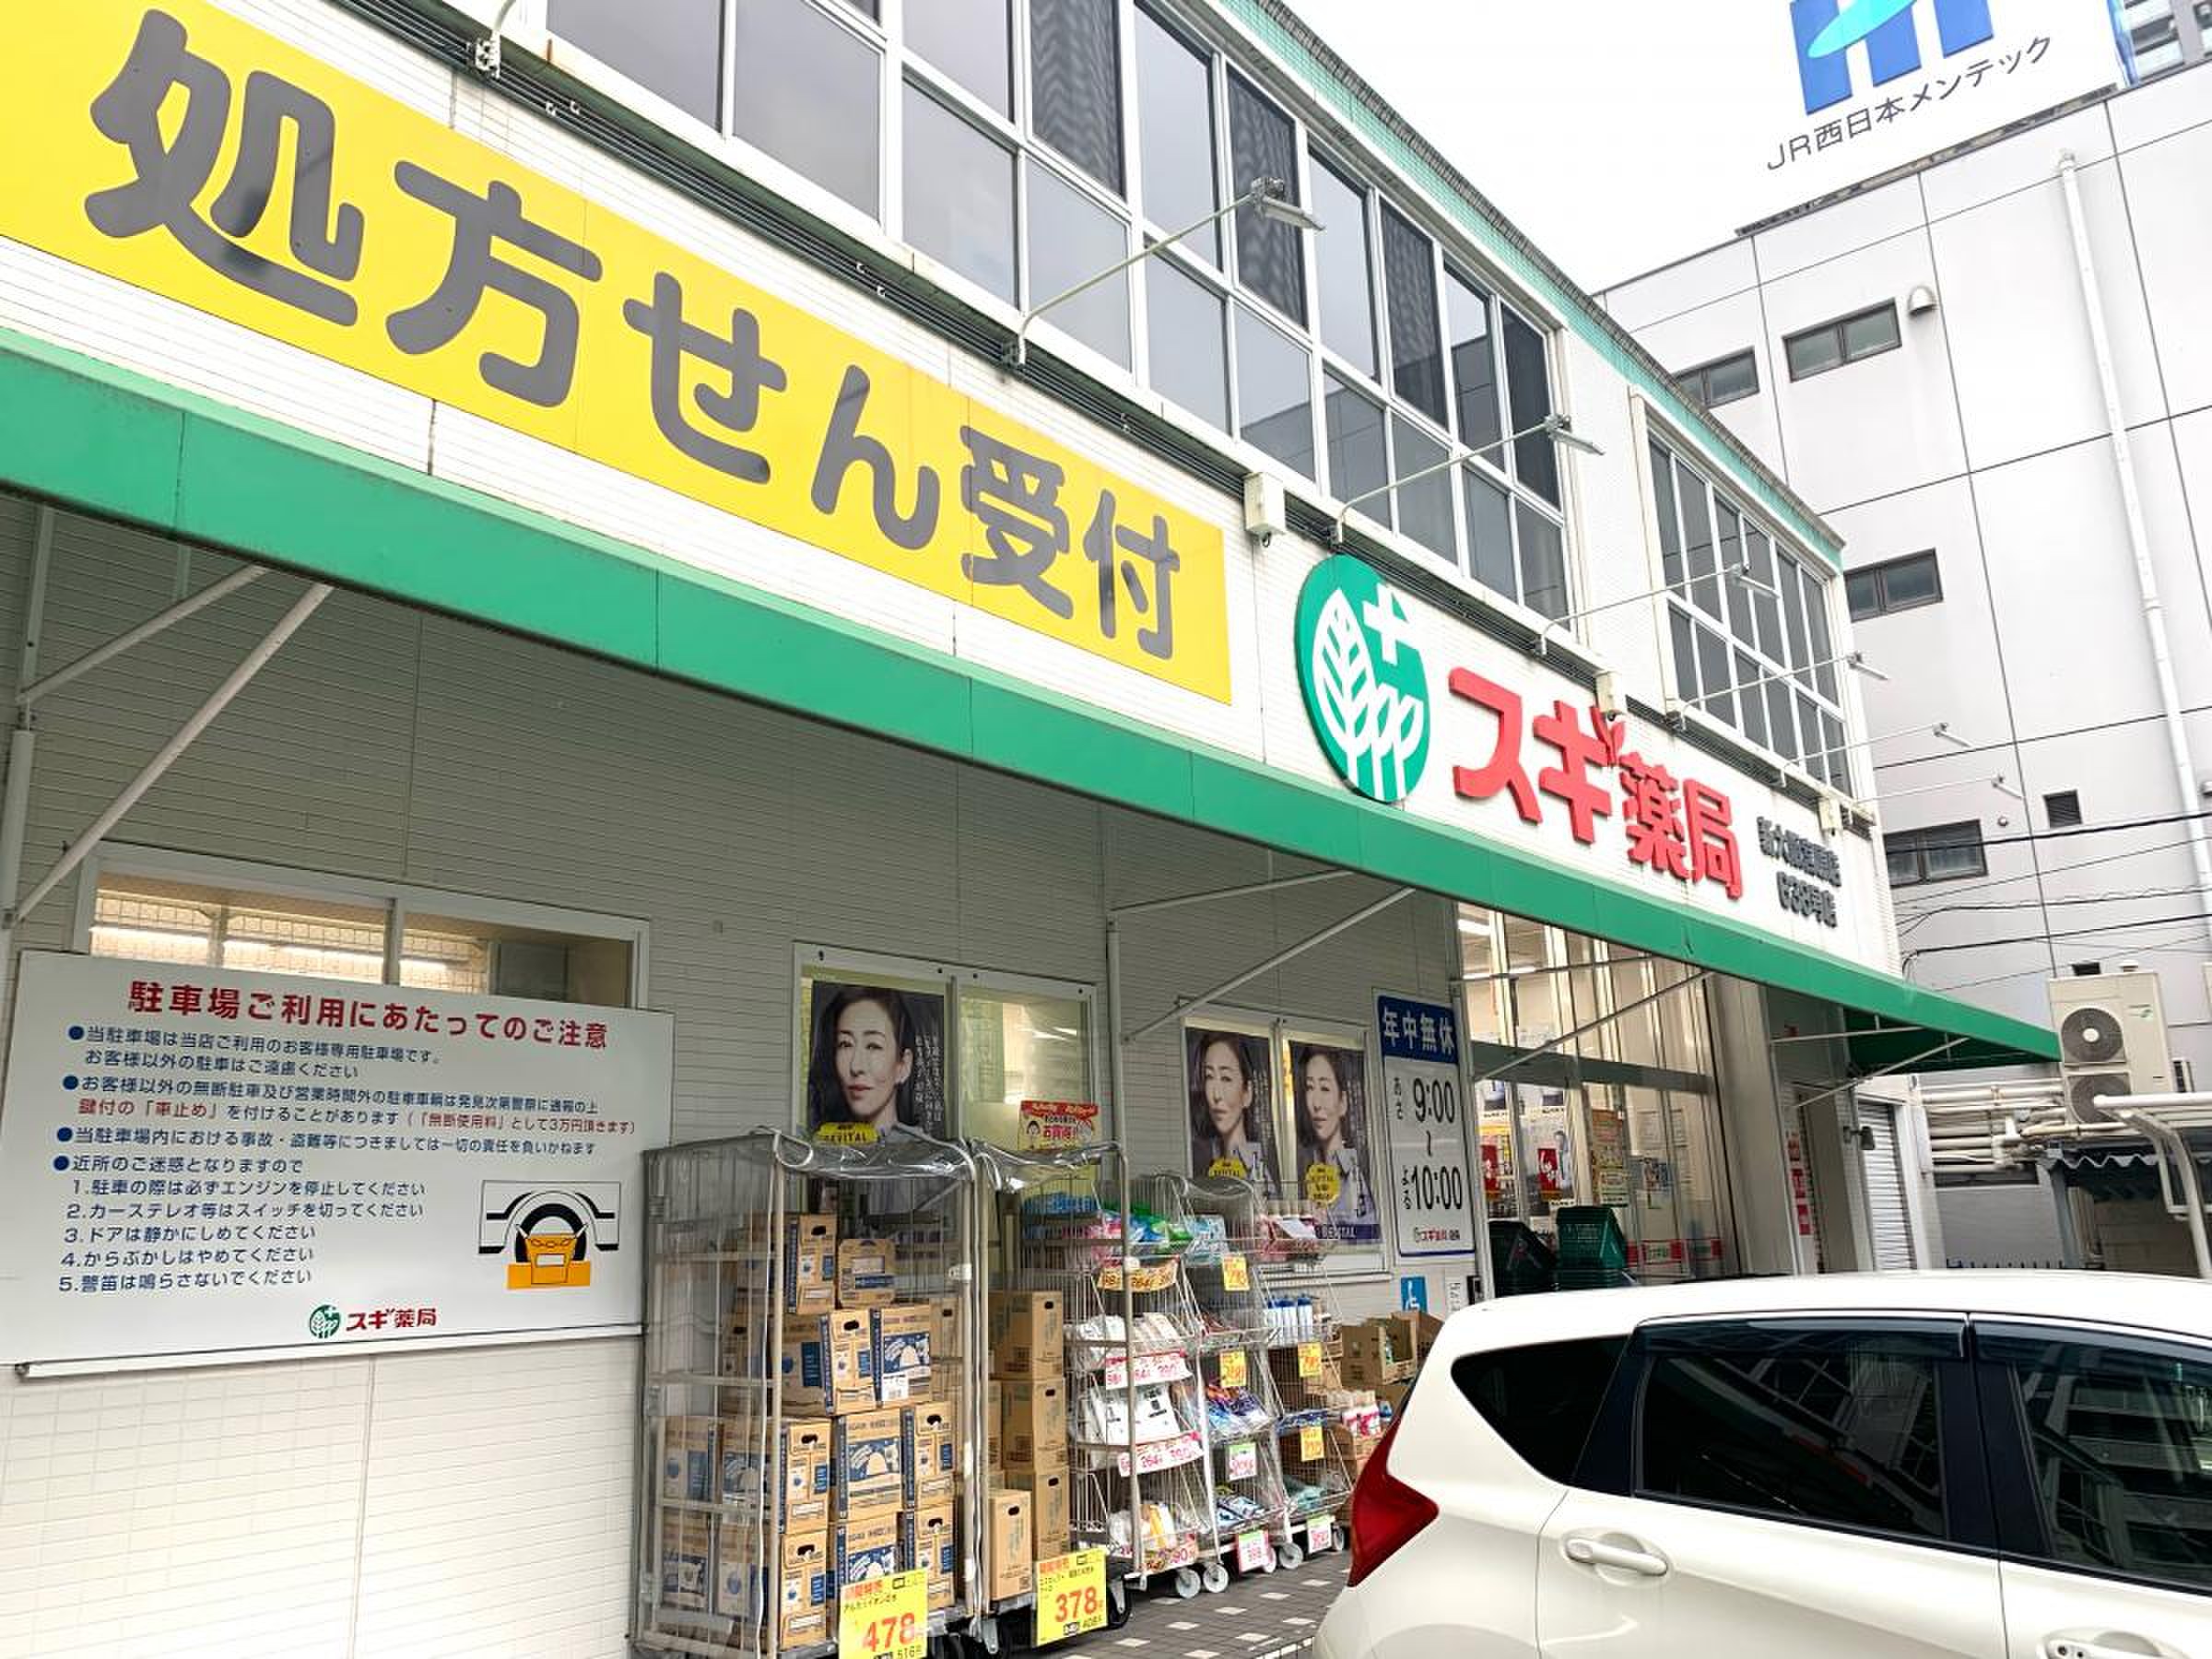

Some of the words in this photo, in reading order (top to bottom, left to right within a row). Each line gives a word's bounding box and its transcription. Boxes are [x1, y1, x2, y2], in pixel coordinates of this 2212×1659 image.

[1767, 35, 2052, 171] JR西日本メンテック
[86, 10, 1181, 660] 処方せん受付
[1448, 665, 1743, 900] スギ薬局
[127, 980, 608, 1049] 駐車場ご利用にあたってのご注意
[1383, 1006, 1455, 1055] 年中無休
[85, 1051, 359, 1078] お客様以外の駐車はご遠慮ください
[87, 1025, 440, 1065] 当駐車場は当店ご利用のお客様専用駐車場です。
[1414, 1077, 1455, 1124] 9:00
[72, 1156, 303, 1174] 近所のご迷惑となりますので
[1412, 1165, 1463, 1210] 10:00
[64, 1226, 316, 1244] 3.ドアは静かにしめてください
[60, 1248, 313, 1268] 4.からぶかしはやめてください
[346, 1307, 438, 1332] スギ薬局
[1054, 1586, 1098, 1623] 378
[863, 1612, 915, 1653] 478
